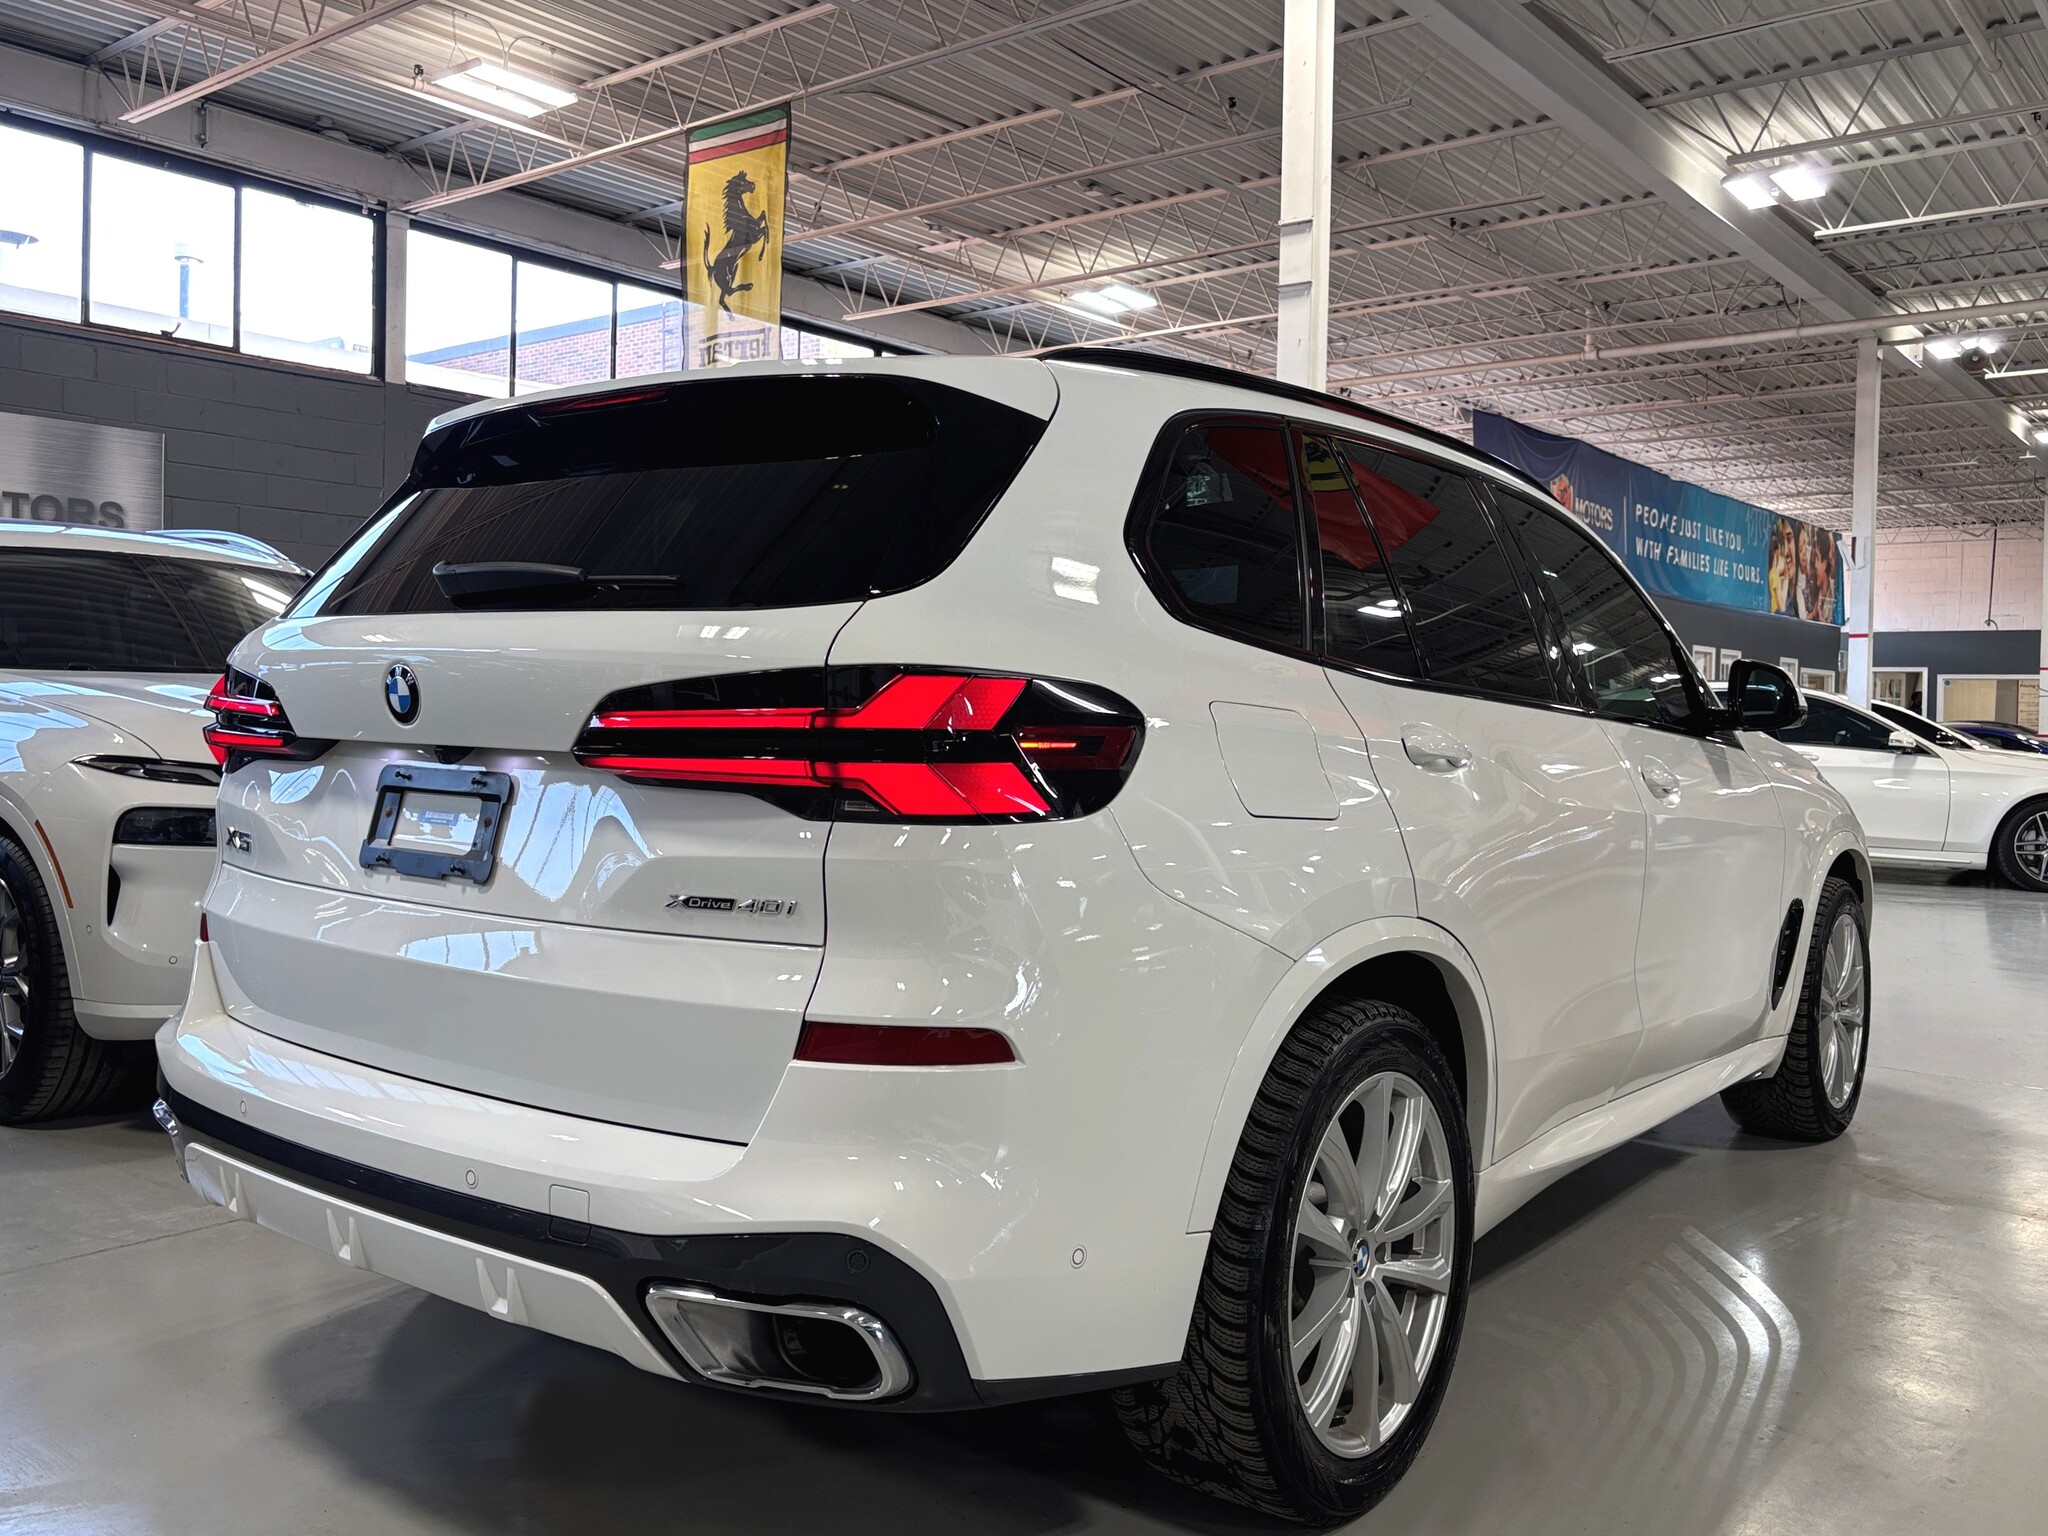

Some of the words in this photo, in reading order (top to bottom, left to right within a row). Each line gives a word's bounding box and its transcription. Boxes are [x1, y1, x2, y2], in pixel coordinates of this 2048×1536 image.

[1575, 496, 1614, 531] MOTORS
[1680, 518, 1702, 540] JUST
[1705, 524, 1723, 547] LIKE
[1635, 536, 1662, 561] WITH
[1666, 545, 1710, 573] FAMILIES
[1713, 557, 1729, 577] LIKE
[1732, 562, 1764, 585] YOURS.
[386, 666, 415, 685] BMW
[226, 826, 252, 854] X5
